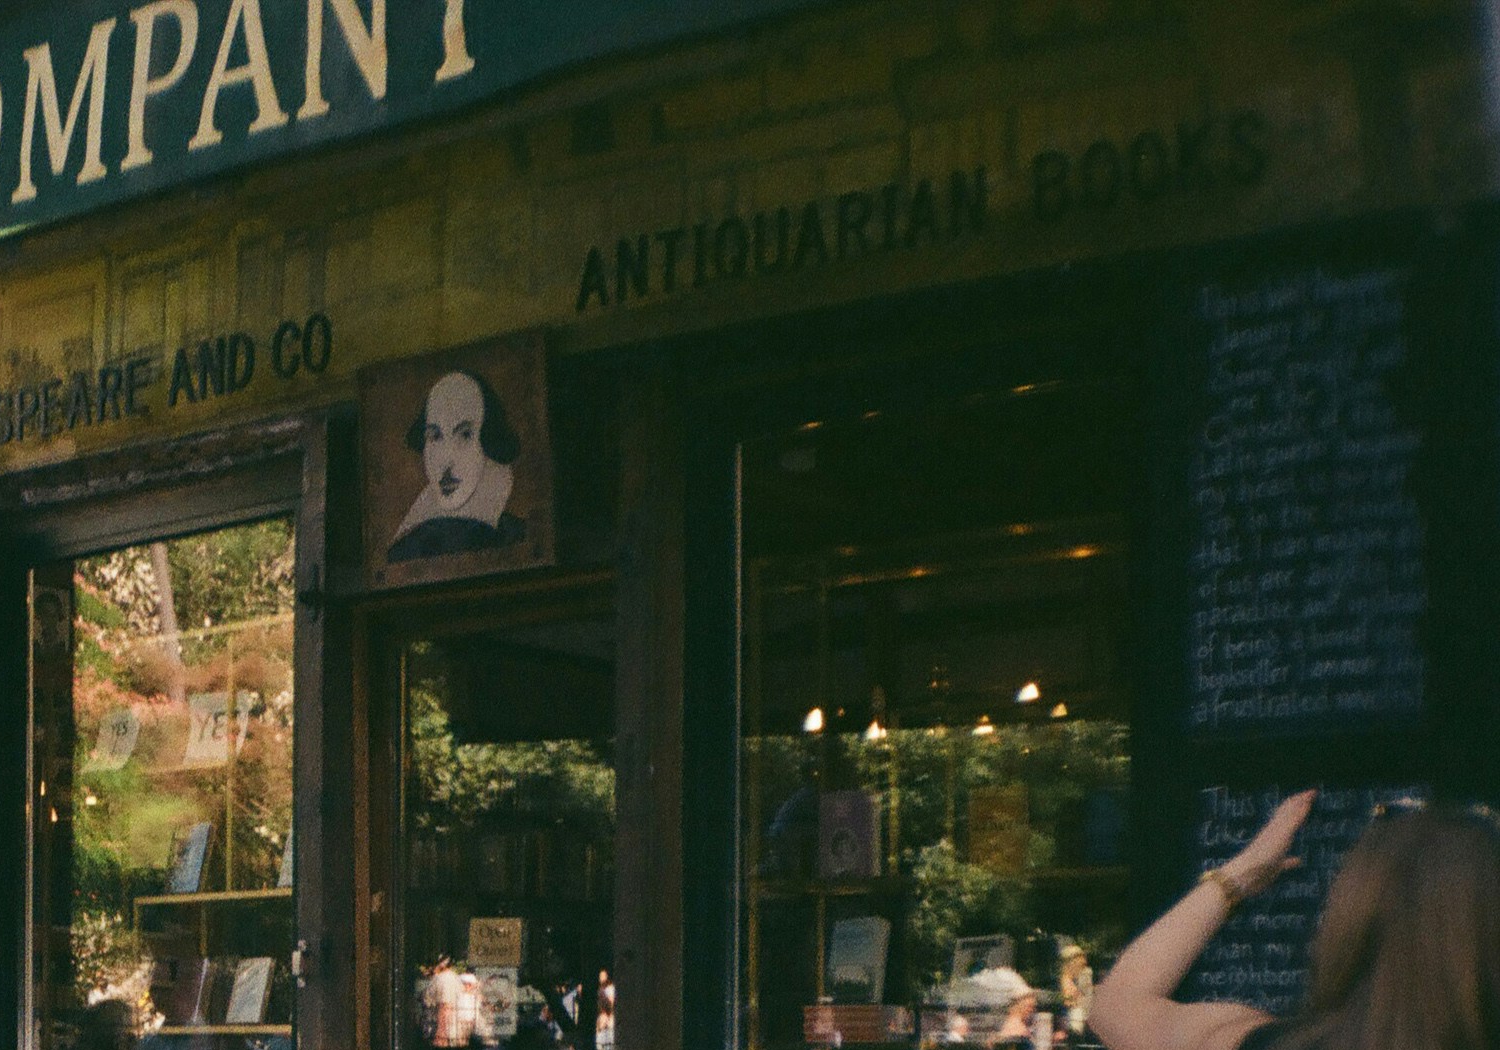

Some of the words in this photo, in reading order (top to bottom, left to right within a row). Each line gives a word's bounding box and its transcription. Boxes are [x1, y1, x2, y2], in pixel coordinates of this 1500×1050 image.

[575, 166, 989, 311] ANTIQUARIAN
[1028, 109, 1270, 222] BOOKS
[168, 331, 255, 408] AND
[271, 313, 333, 376] CO
